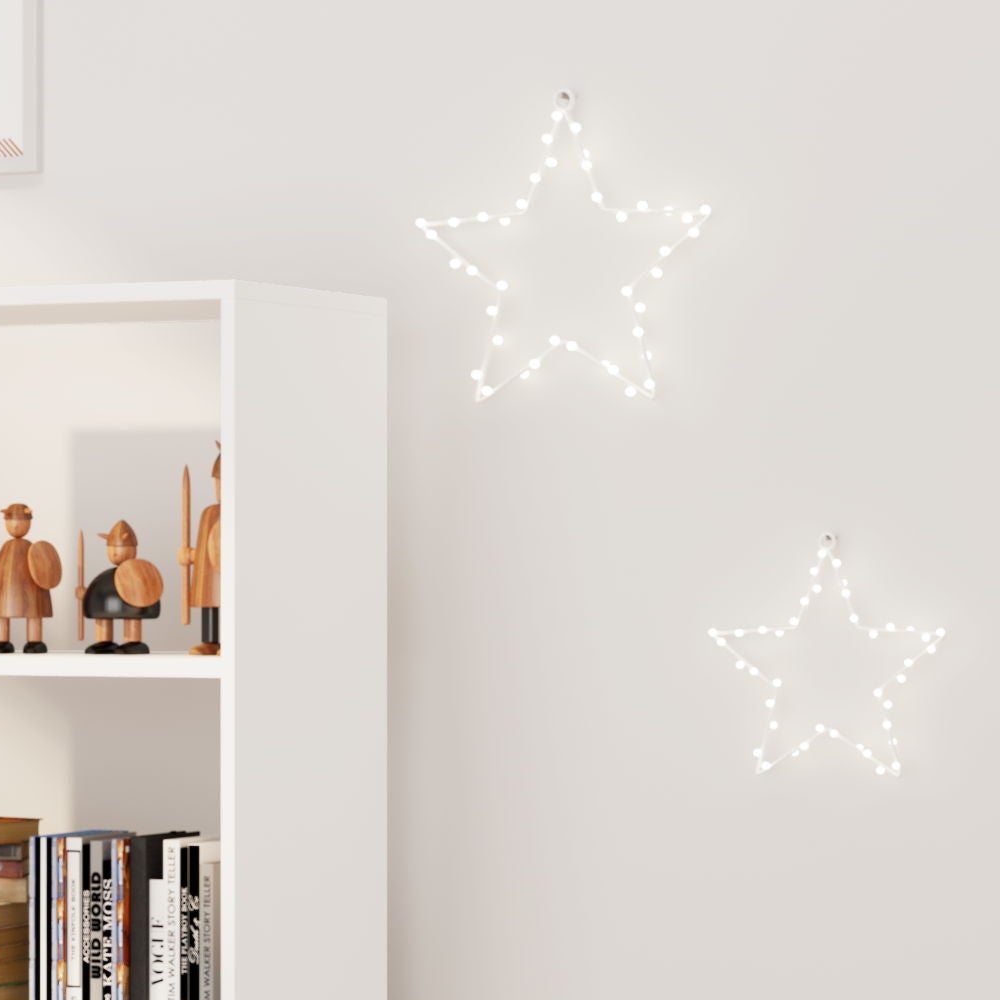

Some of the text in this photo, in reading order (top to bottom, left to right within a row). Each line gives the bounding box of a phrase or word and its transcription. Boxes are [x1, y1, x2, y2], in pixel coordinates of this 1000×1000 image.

[203, 875, 211, 908] TELLER
[91, 872, 101, 979] WILD WORLD
[103, 878, 112, 987] KATE MOSS
[151, 917, 164, 985] VOGUE
[203, 911, 211, 943] STORY
[203, 946, 211, 986] WALKER
